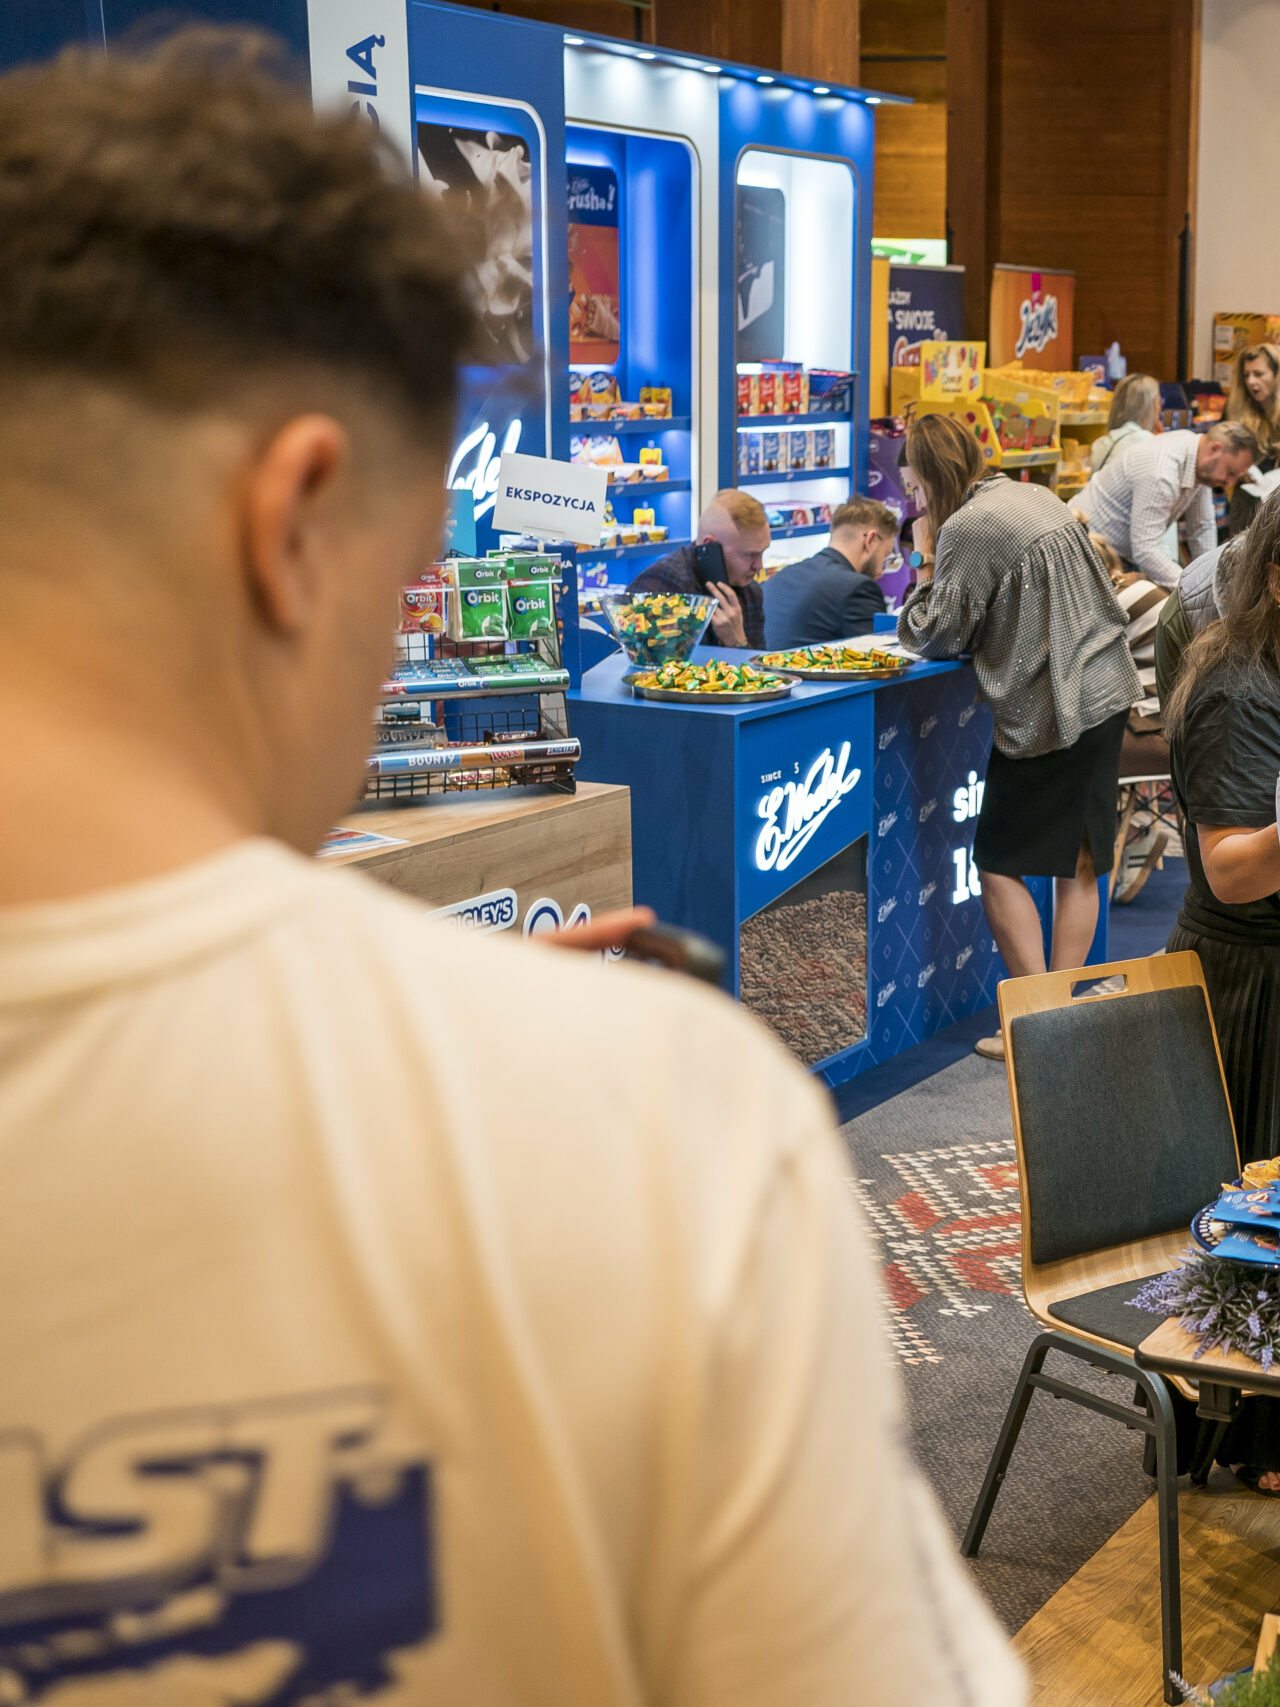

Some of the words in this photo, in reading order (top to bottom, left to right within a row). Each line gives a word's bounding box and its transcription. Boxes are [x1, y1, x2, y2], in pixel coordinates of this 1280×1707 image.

[505, 486, 596, 512] EKSPOZYCJA
[474, 569, 494, 578] Orbit
[529, 565, 549, 575] Orbit
[405, 593, 433, 604] Orbit
[466, 591, 500, 605] Orbit
[514, 598, 546, 611] Orbit
[408, 754, 455, 767] BOUNTY
[490, 749, 520, 762] TWIX
[761, 770, 782, 784] SINCE
[0, 1382, 395, 1600] ST
